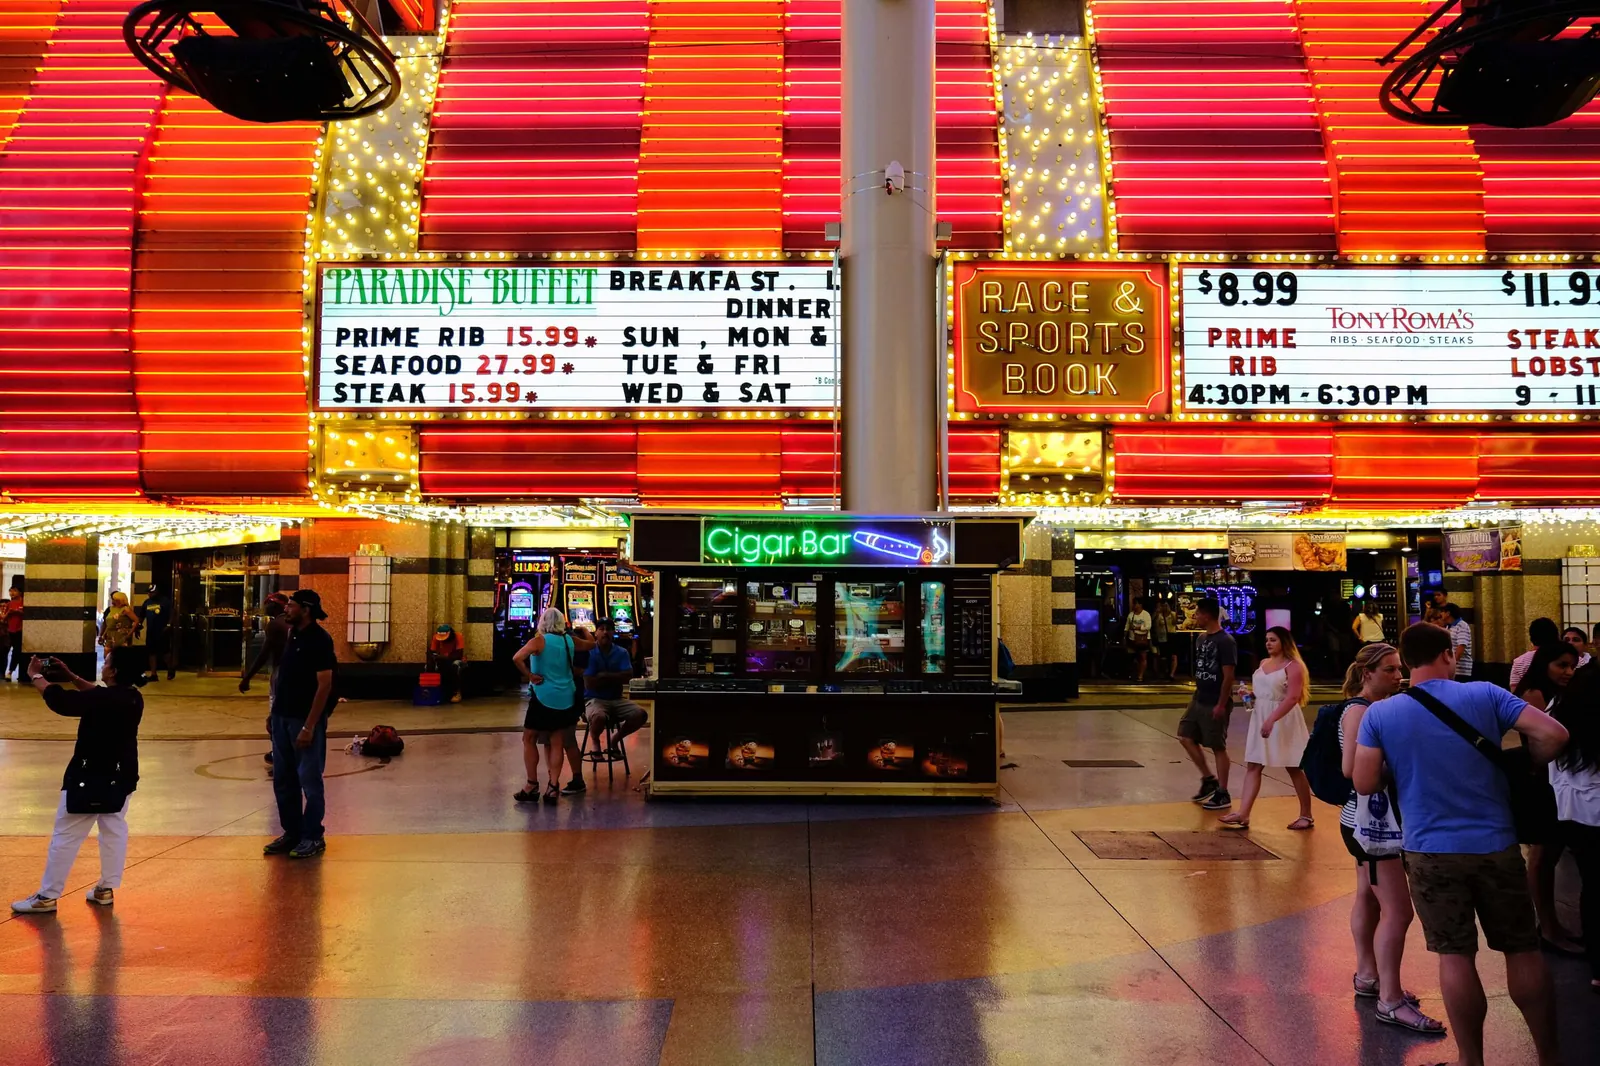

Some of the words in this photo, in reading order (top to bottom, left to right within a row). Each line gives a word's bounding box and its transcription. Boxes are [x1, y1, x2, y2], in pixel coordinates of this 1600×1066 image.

[326, 268, 473, 316] PARADISE
[484, 268, 598, 304] BUFFET
[980, 281, 1090, 314] RACE
[1112, 281, 1144, 314] &
[1198, 270, 1298, 306] $8.99
[1501, 270, 1600, 307] $11.9
[726, 298, 831, 319] DINNER
[335, 327, 420, 347] PRIME
[438, 327, 485, 347] RIB
[621, 326, 680, 347] SUN
[728, 326, 790, 347] MON
[810, 326, 828, 347] &
[976, 321, 1146, 355] SPORTS
[1207, 327, 1297, 349] PRIME
[1330, 335, 1358, 345] RIBS
[1366, 335, 1420, 345] SEAFOOD
[1429, 335, 1474, 345] STEAKS
[1507, 328, 1600, 350] STEAK
[333, 355, 462, 376] SEAFOOD
[621, 354, 679, 375] TUE
[696, 354, 714, 375] &
[734, 354, 780, 375] FRI
[1229, 356, 1278, 377] RIB
[1511, 356, 1600, 377] LOBST
[1002, 363, 1121, 396] BOOK
[333, 382, 427, 404] STEAK
[621, 382, 684, 404] WED
[702, 382, 720, 404] &
[738, 382, 792, 404] SAT
[1188, 384, 1290, 405] 4:30PM
[1318, 384, 1428, 405] 6:30PM
[1515, 385, 1531, 406] 9
[706, 525, 795, 562] Cigar
[802, 529, 852, 556] Bar
